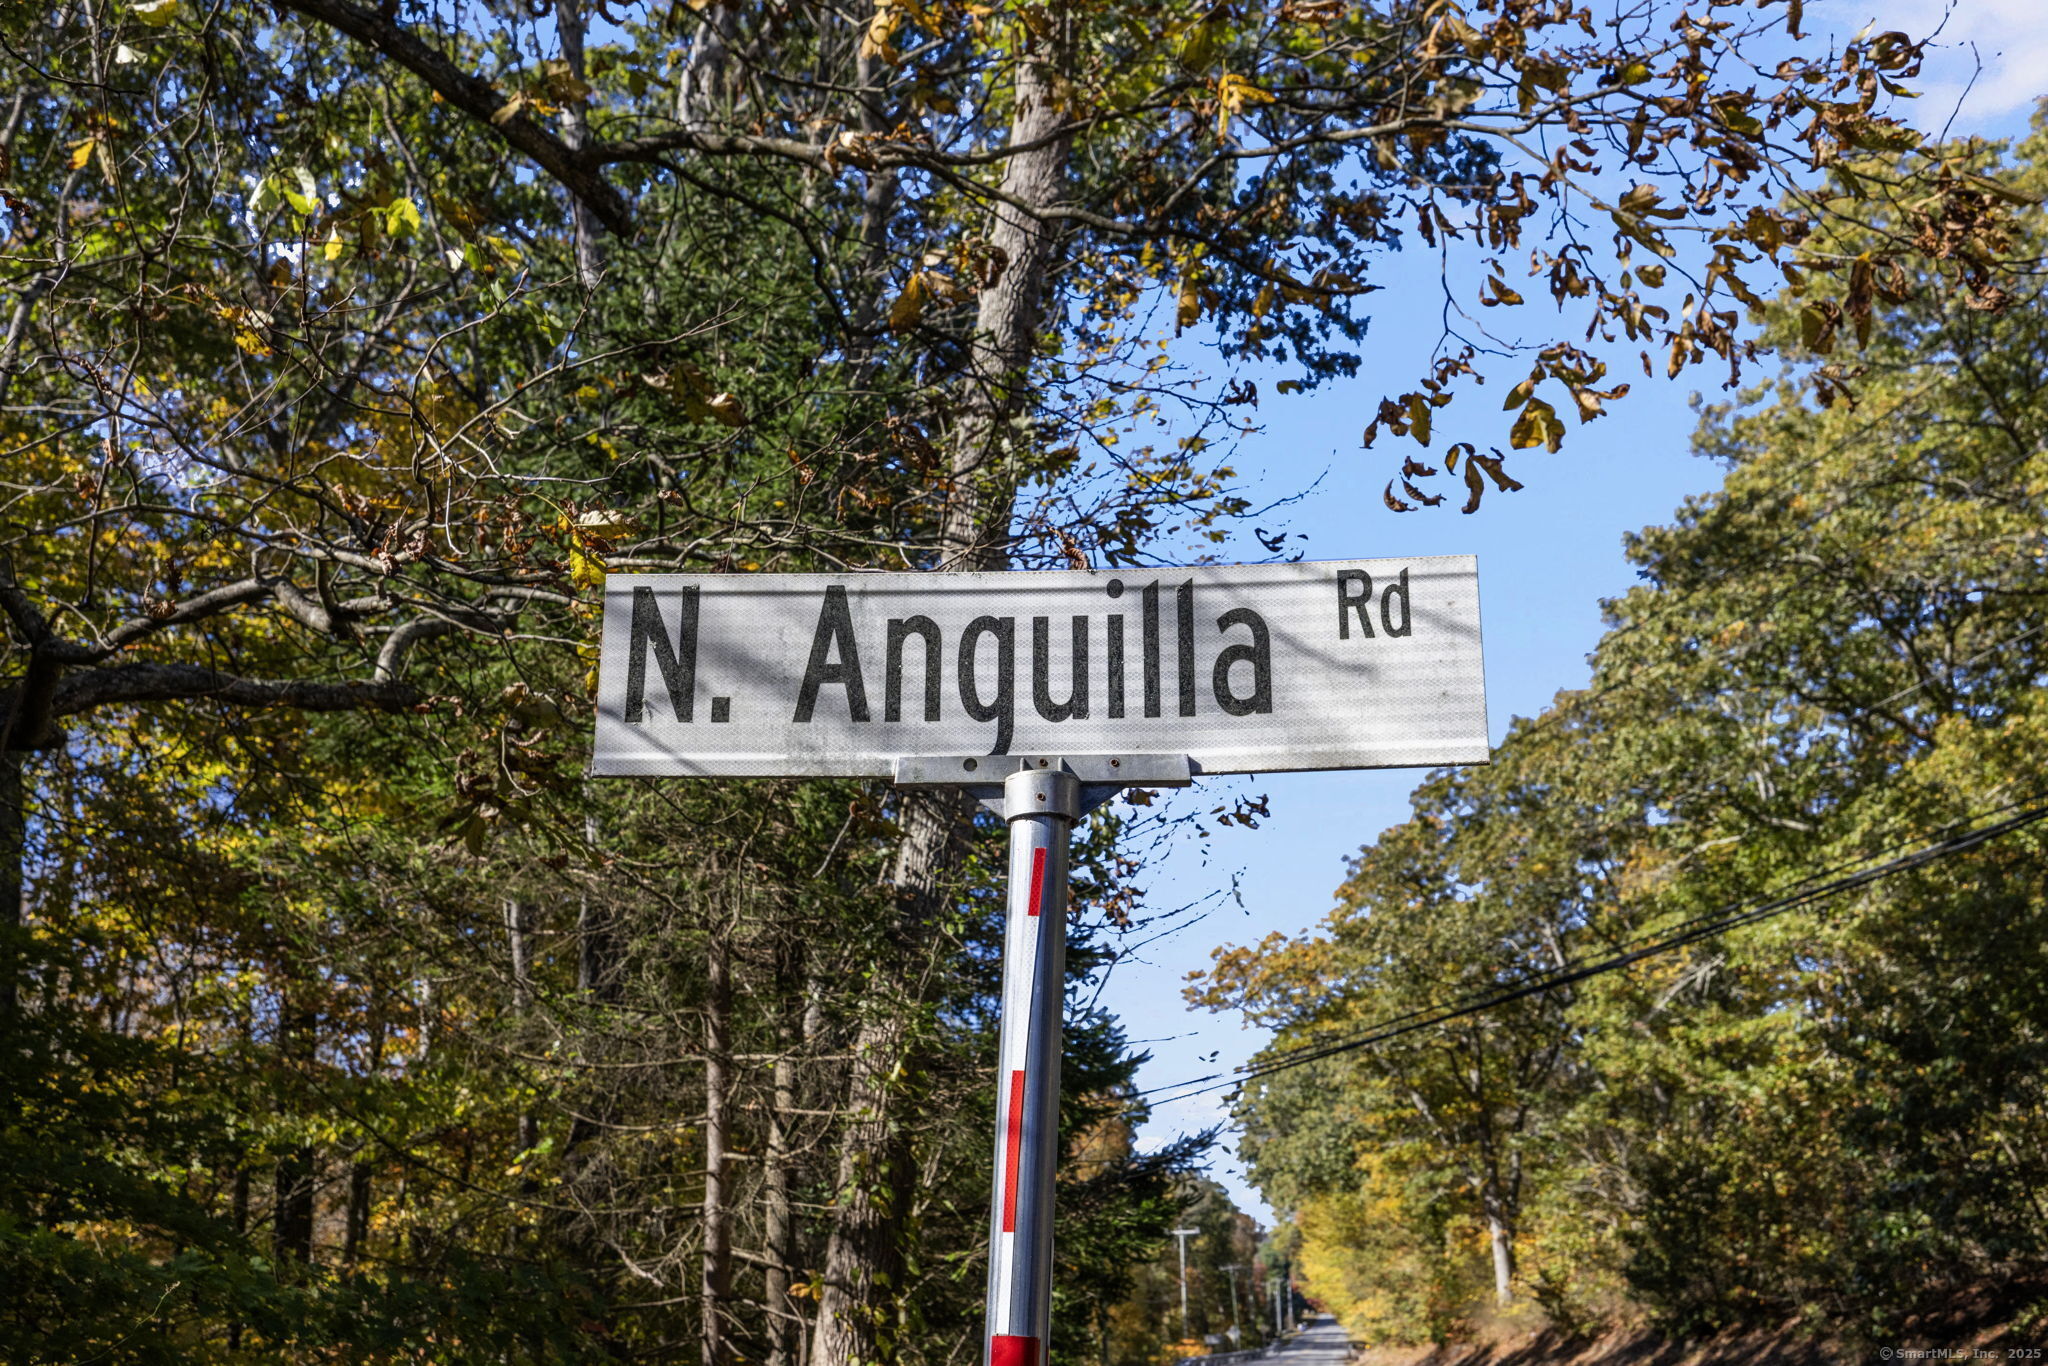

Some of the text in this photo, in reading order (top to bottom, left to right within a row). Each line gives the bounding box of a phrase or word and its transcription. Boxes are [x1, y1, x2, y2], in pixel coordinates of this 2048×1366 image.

[624, 567, 1413, 757] N. Anguilla Rd
